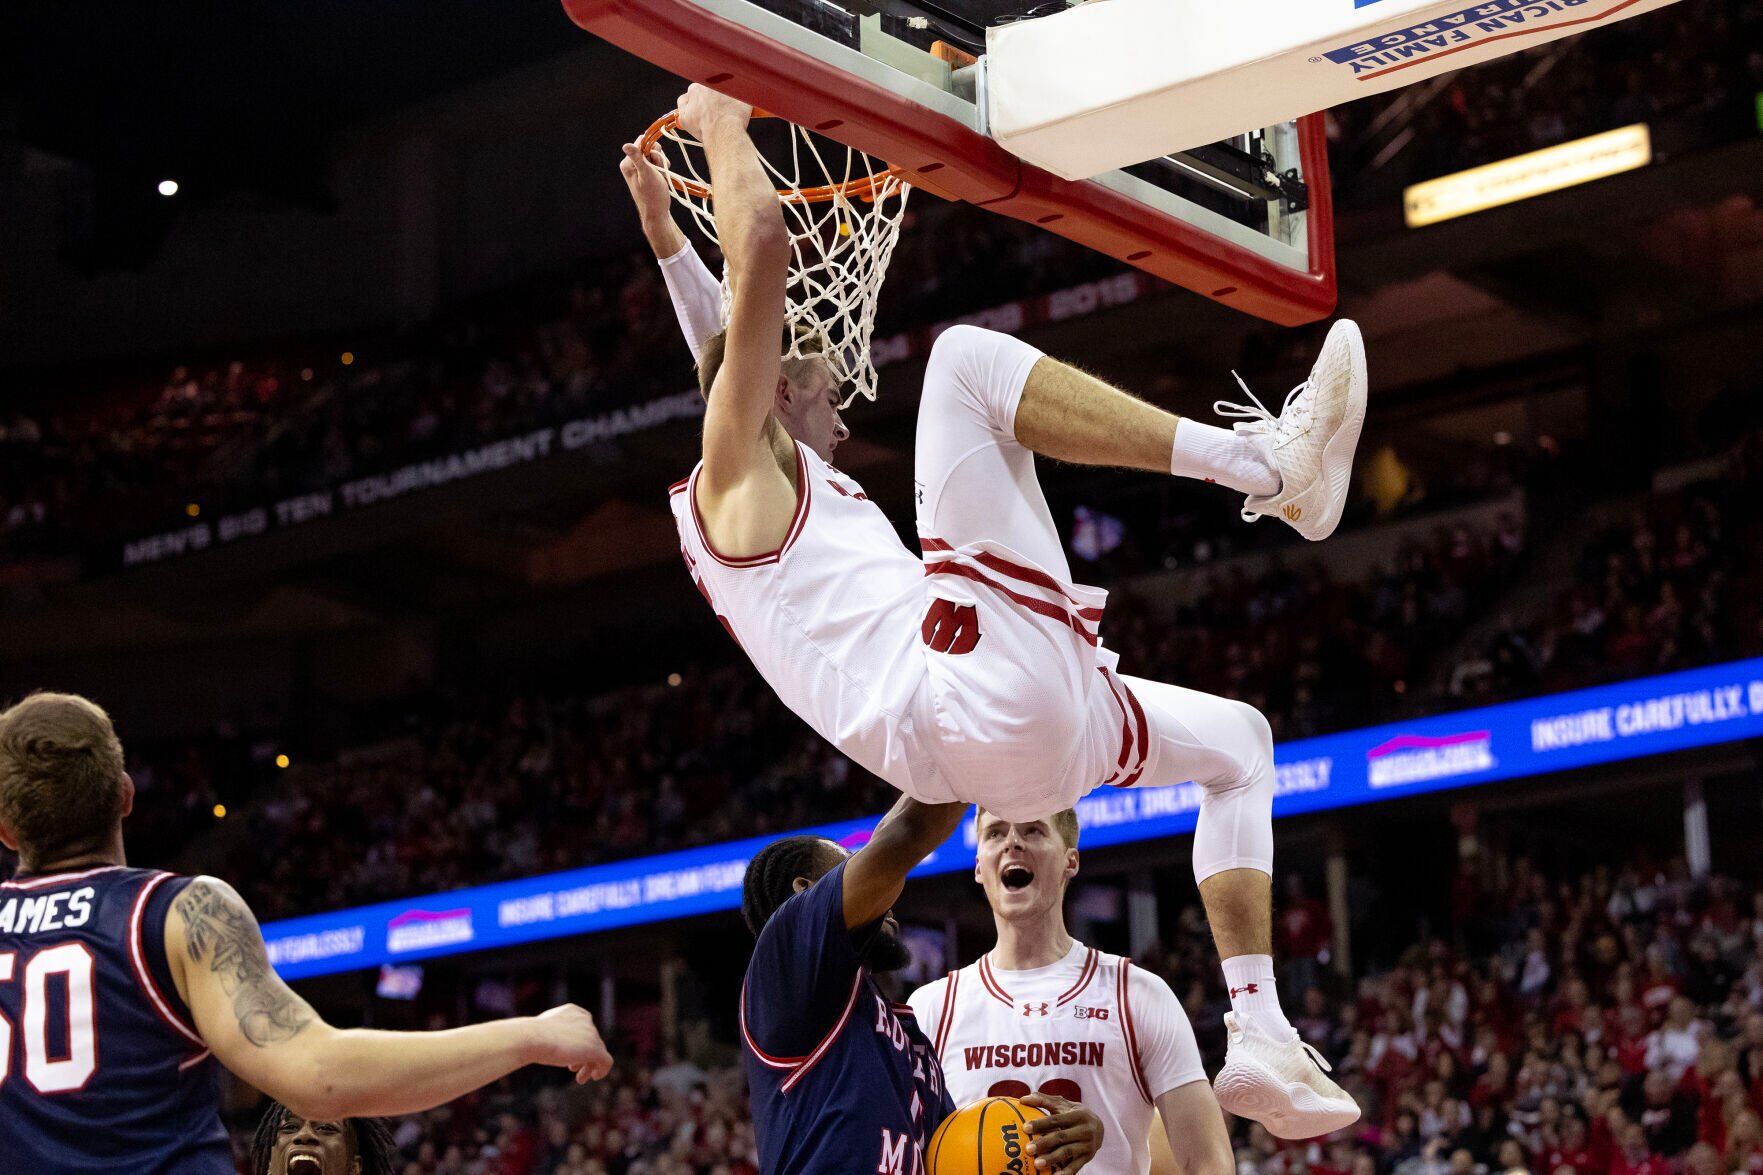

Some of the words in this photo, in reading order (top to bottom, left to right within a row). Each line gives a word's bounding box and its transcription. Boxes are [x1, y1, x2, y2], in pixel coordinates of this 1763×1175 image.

[1349, 30, 1471, 73] FAMILY
[275, 492, 333, 526] TEN
[341, 428, 553, 507] TOURNAMENT
[0, 940, 98, 1095] 0
[964, 1041, 1105, 1071] WISCONSIN
